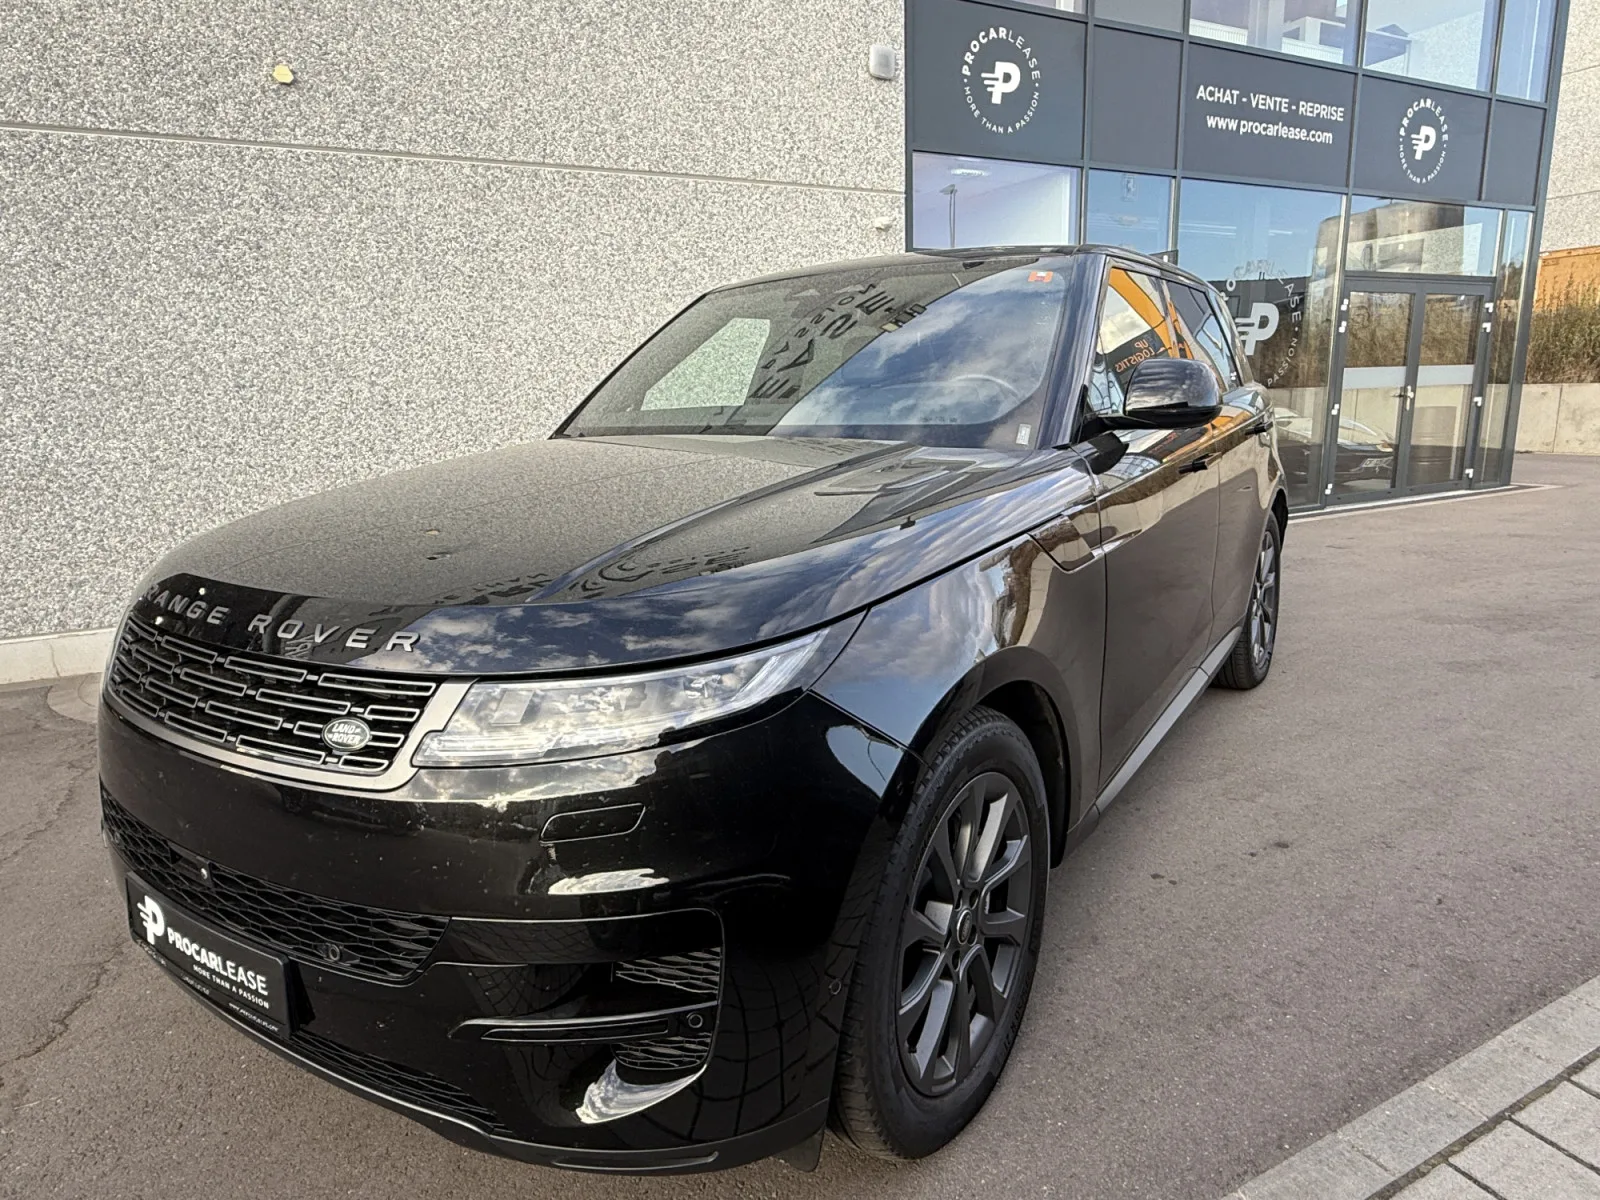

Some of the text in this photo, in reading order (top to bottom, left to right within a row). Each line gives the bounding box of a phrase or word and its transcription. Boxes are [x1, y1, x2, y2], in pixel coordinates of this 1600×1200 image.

[962, 27, 1041, 80] PROCARLEASE
[964, 86, 981, 118] MORE
[981, 117, 1004, 134] THAN
[1015, 92, 1039, 130] PASSION
[1196, 85, 1240, 105] ACHAT
[1250, 93, 1289, 113] VENTE
[1298, 101, 1345, 121] REPRISE
[1399, 98, 1449, 141] PROCARLEASE
[1399, 144, 1408, 170] MORE
[1406, 169, 1420, 184] THAN
[1427, 150, 1446, 182] PASSION
[1267, 338, 1298, 387] PASSION
[248, 614, 421, 652] ROVER
[332, 723, 356, 733] LAND
[167, 927, 268, 996] PROCARLEASE
[193, 964, 211, 979] MORE
[212, 974, 230, 989] THAN
[232, 985, 237, 993] A
[238, 988, 269, 1009] PASSION
